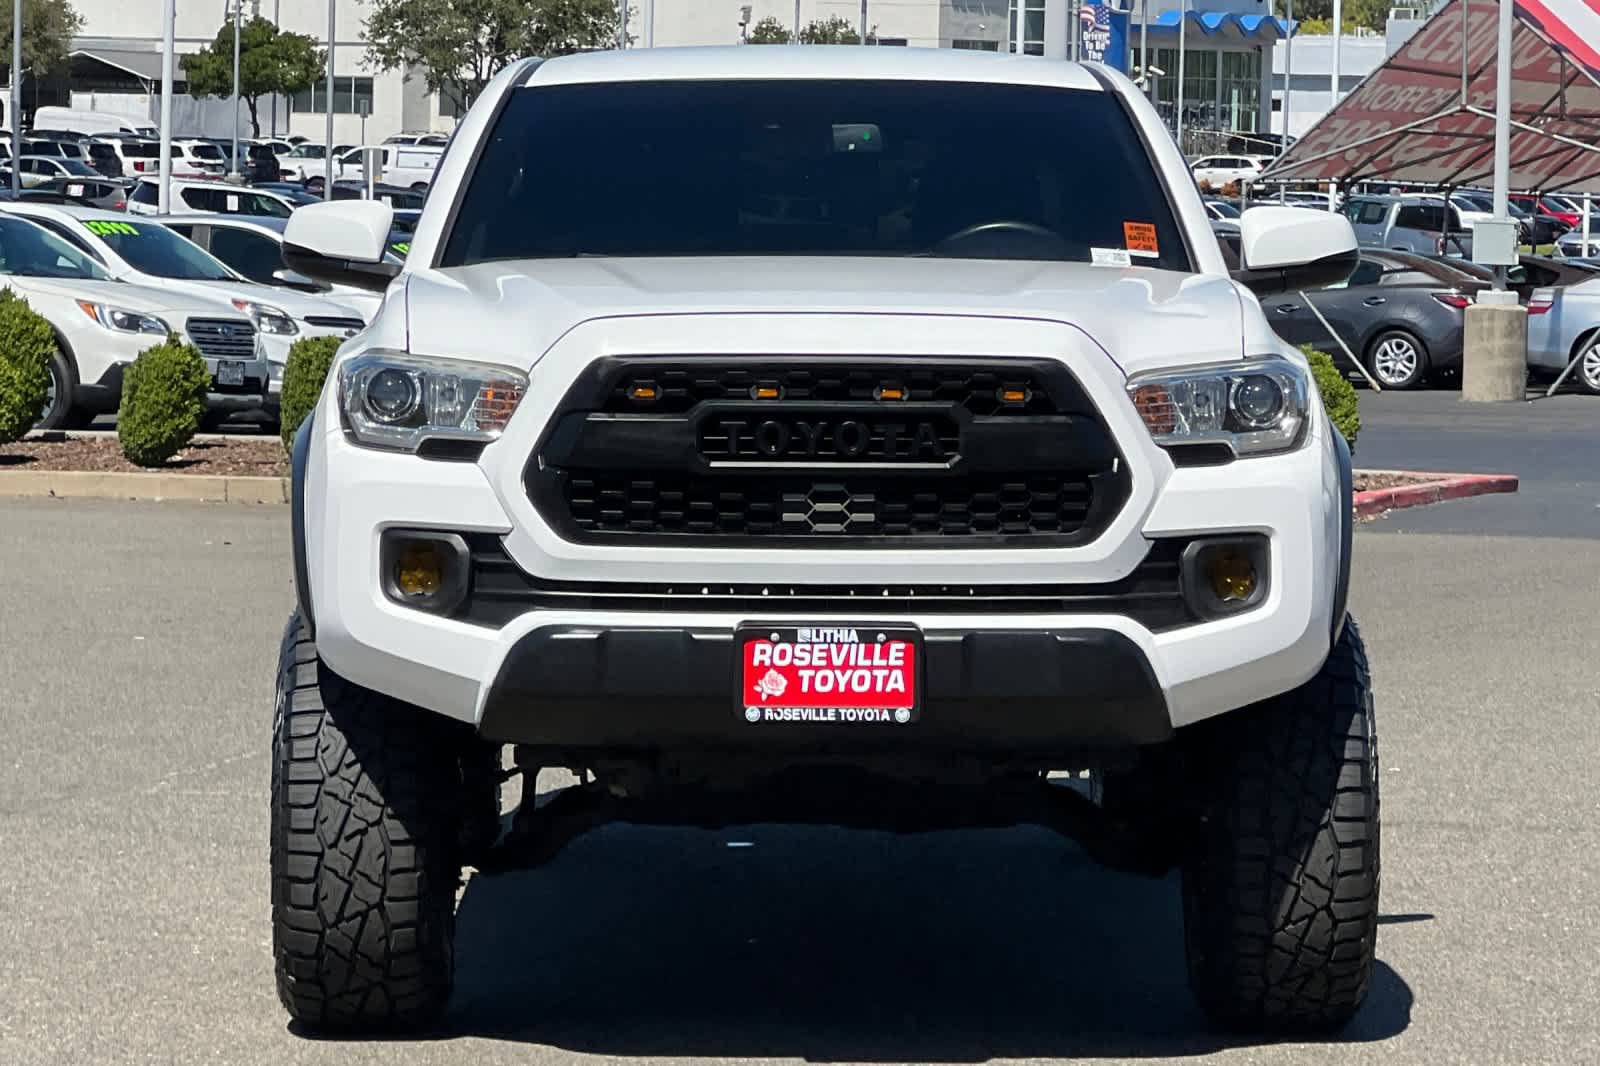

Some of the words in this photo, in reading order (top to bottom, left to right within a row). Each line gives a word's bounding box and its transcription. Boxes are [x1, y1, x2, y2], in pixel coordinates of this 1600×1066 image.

[720, 420, 945, 457] TOYOTA
[812, 628, 860, 642] LITHIA
[753, 643, 906, 667] ROSEVILLE
[798, 669, 906, 693] TOYOTA
[765, 708, 835, 721] ROSEVILLE
[839, 708, 890, 721] TOYOTA
